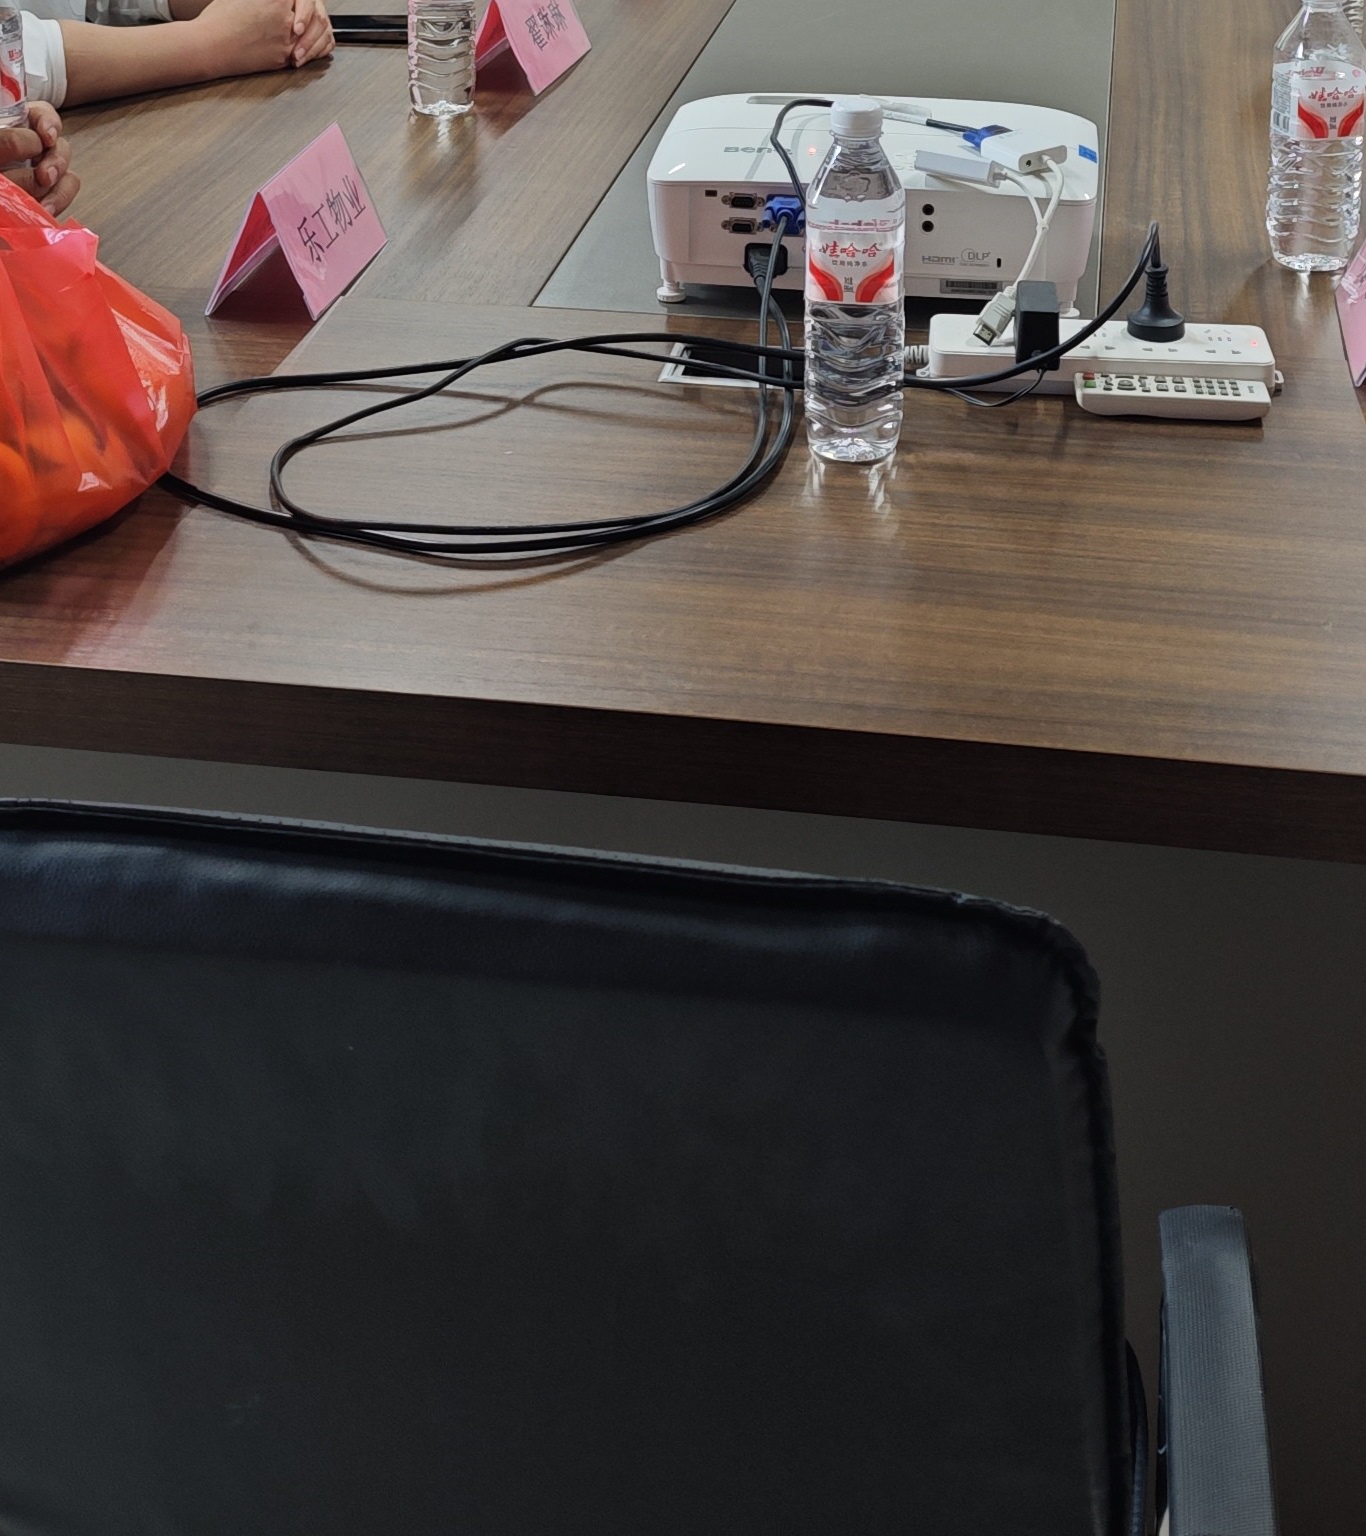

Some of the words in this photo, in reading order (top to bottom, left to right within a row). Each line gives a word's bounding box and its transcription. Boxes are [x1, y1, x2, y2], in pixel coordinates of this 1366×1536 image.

[1308, 86, 1357, 101] 娃哈哈
[296, 174, 367, 263] 乐工物业
[818, 240, 882, 258] 娃哈哈
